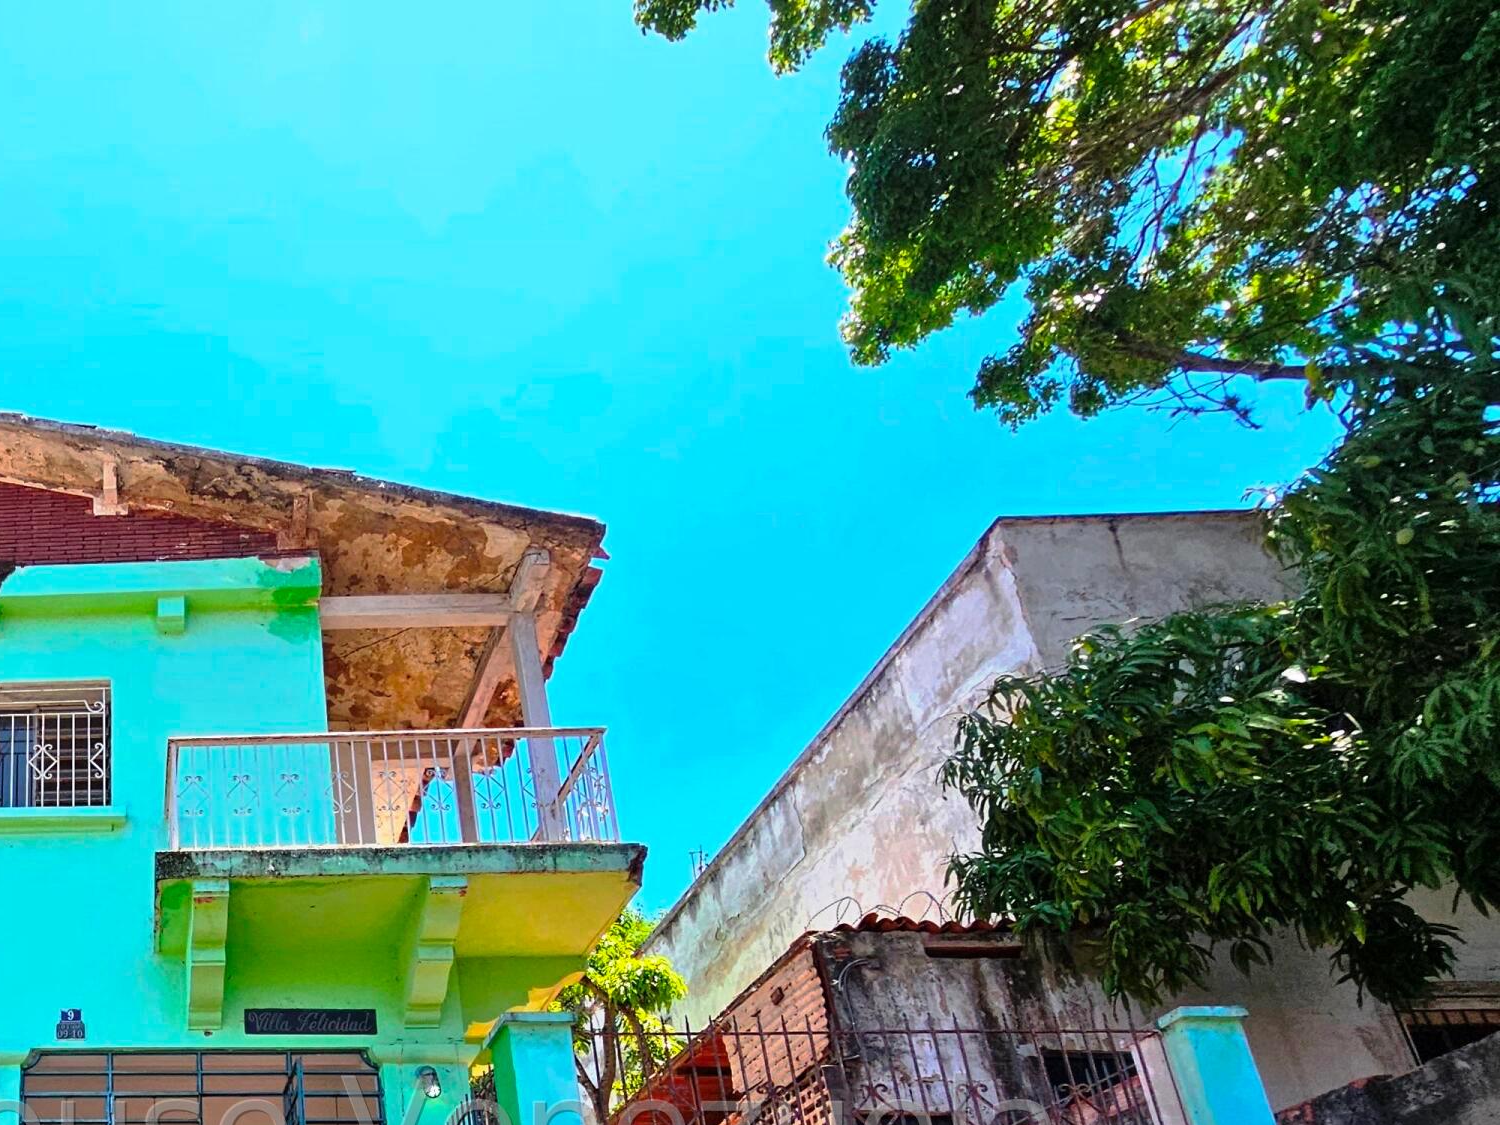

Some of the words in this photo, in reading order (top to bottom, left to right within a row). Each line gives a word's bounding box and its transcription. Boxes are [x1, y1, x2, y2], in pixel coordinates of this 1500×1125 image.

[67, 1010, 74, 1020] 9
[248, 1011, 291, 1032] Villa
[296, 1012, 373, 1032] Felicidad
